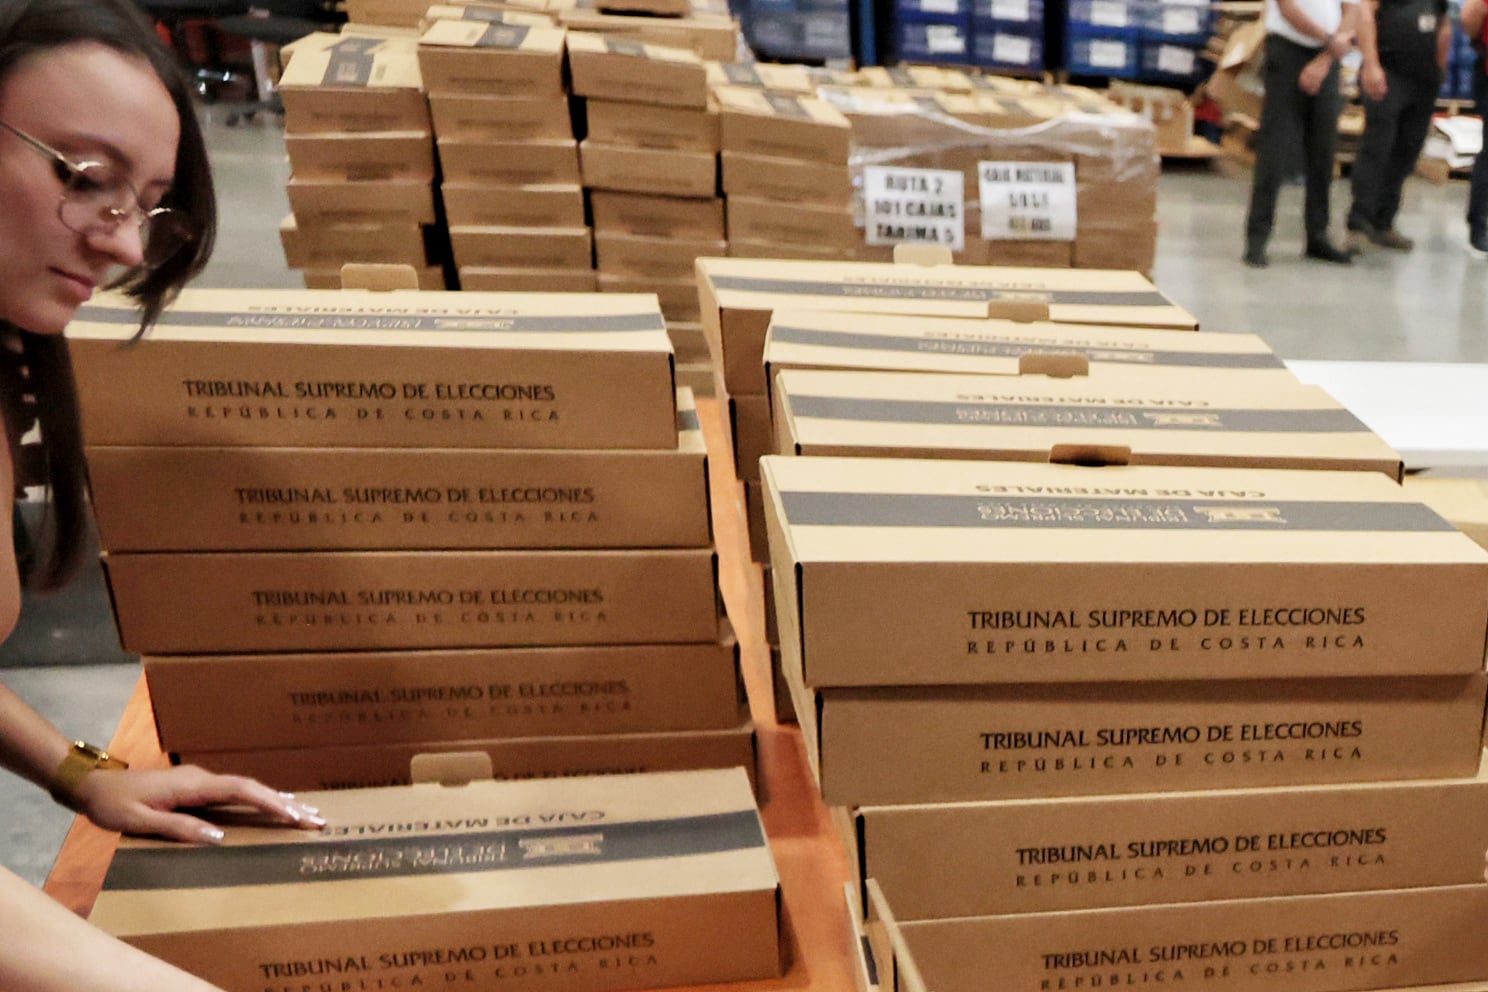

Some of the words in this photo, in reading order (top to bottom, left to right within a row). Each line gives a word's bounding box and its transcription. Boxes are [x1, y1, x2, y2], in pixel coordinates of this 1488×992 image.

[884, 174, 929, 192] RUTA
[905, 201, 957, 218] CAJAS
[182, 380, 288, 398] TRIBUNAL
[295, 381, 397, 399] SUPREMO
[402, 382, 429, 400] DE
[435, 383, 556, 401] ELECCIONES
[356, 408, 385, 420] DE
[404, 408, 484, 420] COSTA
[503, 409, 560, 421] RICA
[234, 487, 336, 504] TRIBUNAL
[343, 487, 442, 504] SUPREMO
[447, 487, 470, 503] DE
[479, 487, 595, 504] ELECCIONES
[252, 589, 350, 606] TRIBUNAL
[358, 589, 454, 606] SUPREMO
[459, 589, 482, 605] DE
[490, 588, 605, 605] ELECCIONES
[966, 609, 1082, 630] TRIBUNAL
[1088, 608, 1198, 629] SUPREMO
[1203, 608, 1232, 627] DE
[1238, 607, 1366, 627] ELECCIONES
[967, 637, 1129, 655] REPÚBLICA
[1150, 638, 1180, 652] DE
[1200, 636, 1285, 651] COSTA
[1305, 634, 1365, 649] RICA
[289, 688, 381, 706] TRIBUNAL
[390, 685, 484, 703] SUPREMO
[488, 684, 512, 699] DE
[518, 680, 630, 699] ELECCIONES
[979, 729, 1089, 750] TRIBUNAL
[1096, 725, 1201, 747] SUPREMO
[1206, 724, 1233, 743] DE
[1240, 720, 1362, 742] ELECCIONES
[980, 754, 1135, 774] REPÚBLICA
[1155, 753, 1182, 768] DE
[1204, 750, 1285, 765] COSTA
[1305, 746, 1362, 761] RICA
[1015, 843, 1121, 866] TRIBUNAL
[1127, 837, 1229, 859] SUPREMO
[1234, 834, 1261, 852] DE
[1267, 827, 1387, 850] ELECCIONES
[1016, 867, 1165, 888] REPÚBLICA
[1184, 862, 1213, 878] DE
[1232, 857, 1310, 875] COSTA
[1330, 853, 1386, 868] RICA
[258, 954, 373, 980] TRIBUNAL
[378, 944, 487, 969] SUPREMO
[493, 943, 521, 961] DE
[527, 931, 655, 958] ELECCIONES
[1041, 947, 1143, 970] TRIBUNAL
[1149, 940, 1247, 963] SUPREMO
[1252, 937, 1278, 956] DE
[1284, 929, 1399, 952] ELECCIONES
[1203, 965, 1231, 981] DE
[1249, 958, 1326, 975] COSTA
[1344, 953, 1399, 968] RICA
